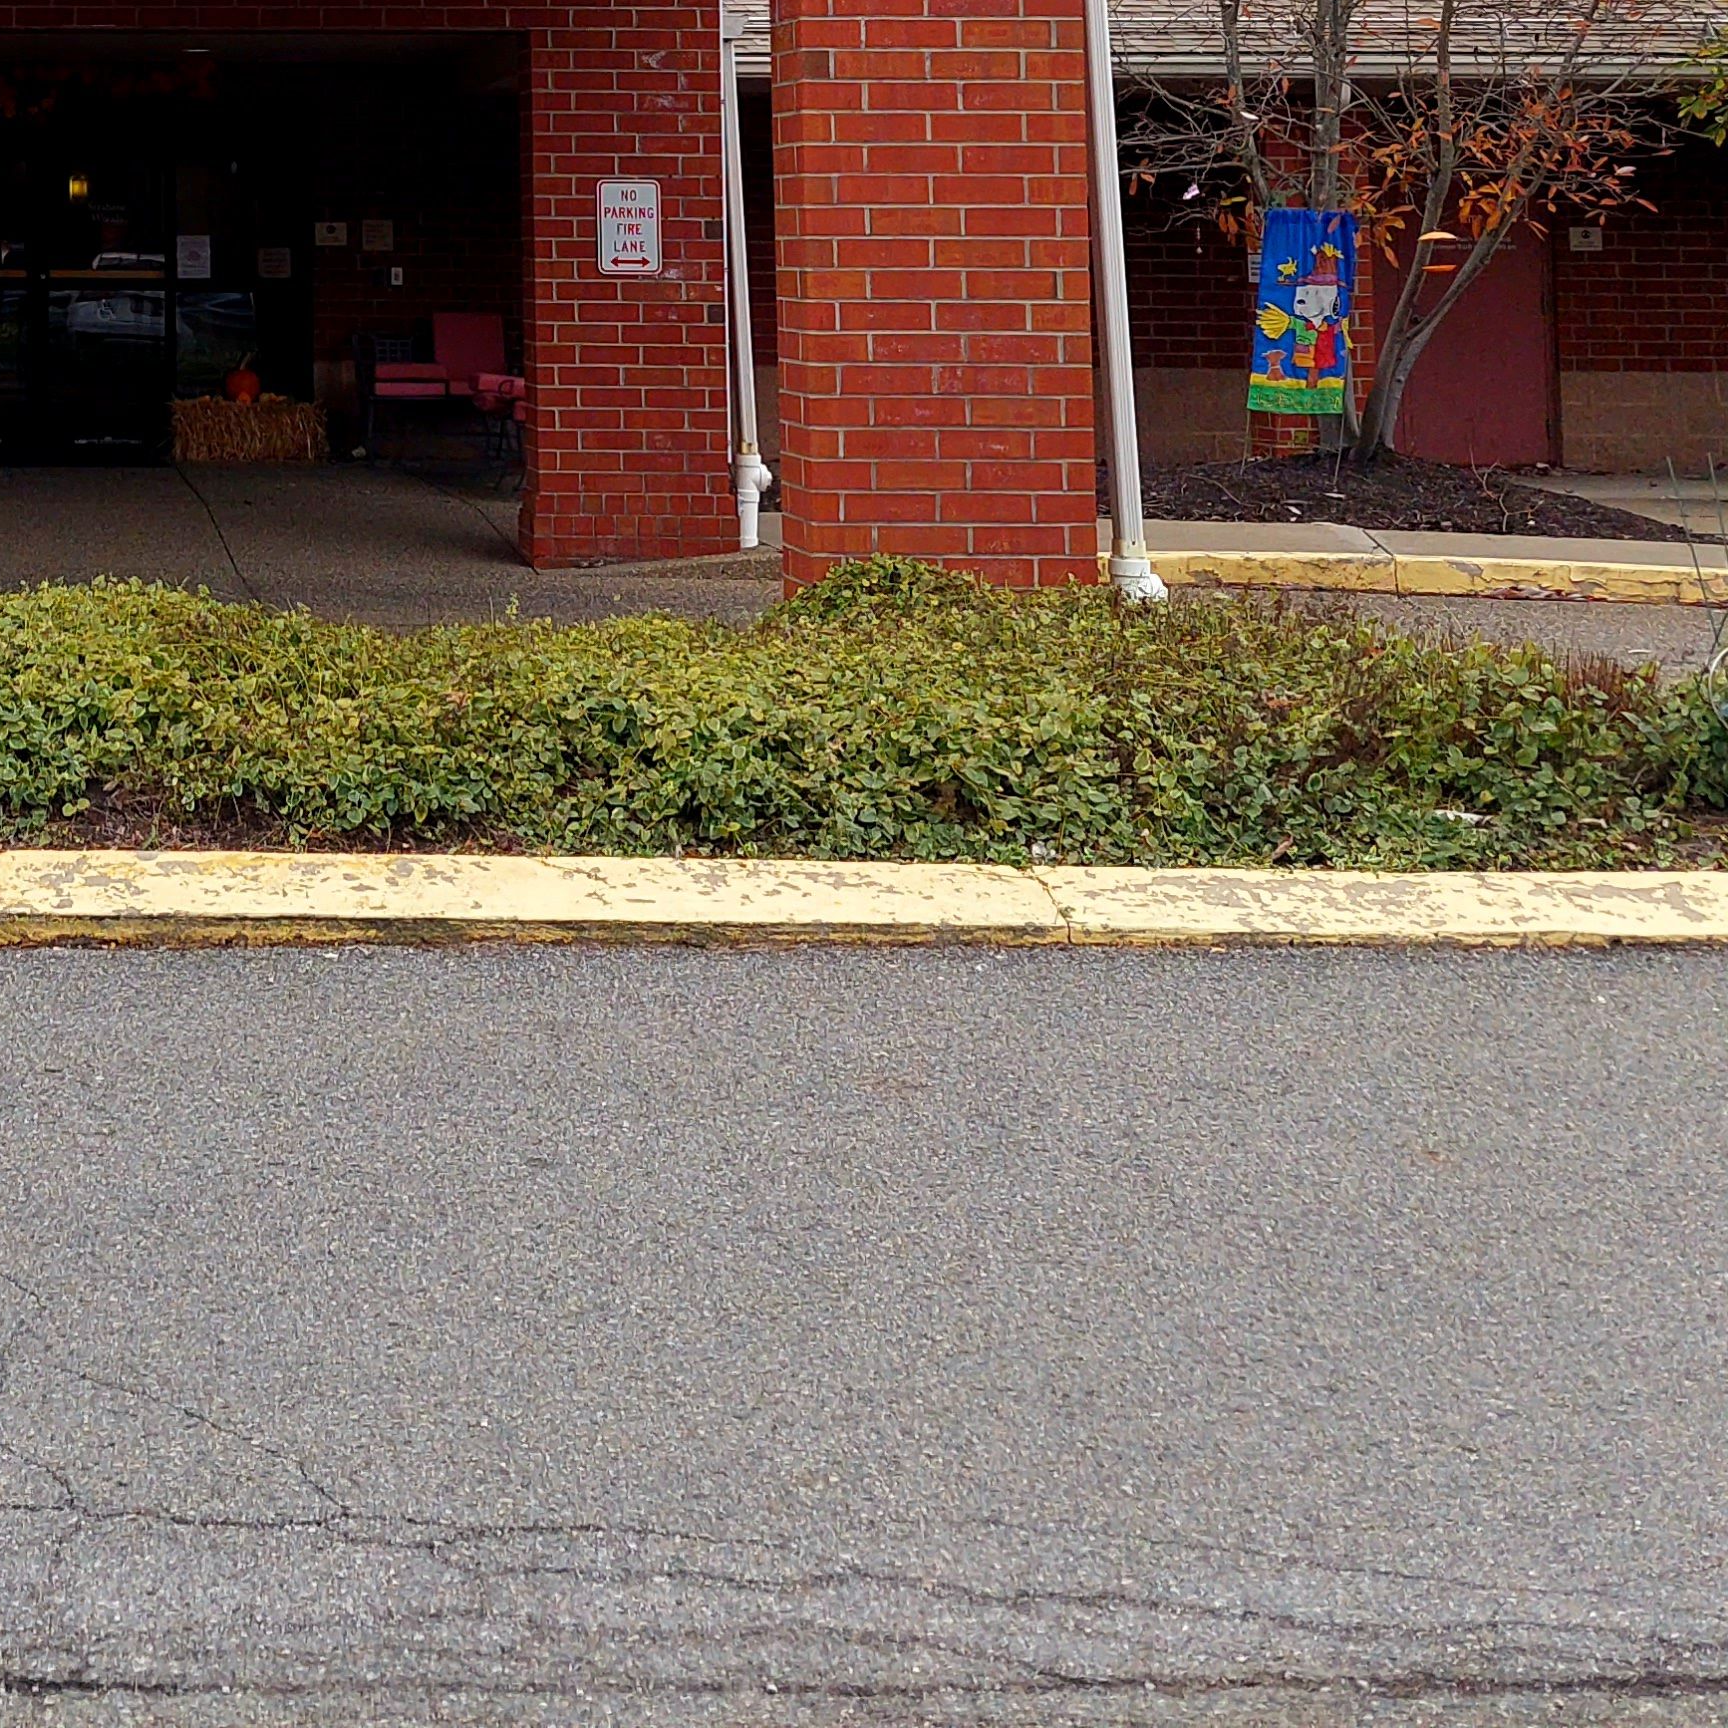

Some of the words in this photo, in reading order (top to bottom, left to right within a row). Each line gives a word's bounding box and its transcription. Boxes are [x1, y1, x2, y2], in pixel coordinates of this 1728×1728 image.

[620, 189, 637, 201] NO
[604, 206, 654, 219] PARKING
[617, 223, 642, 235] FIRE
[614, 240, 646, 252] LANE
